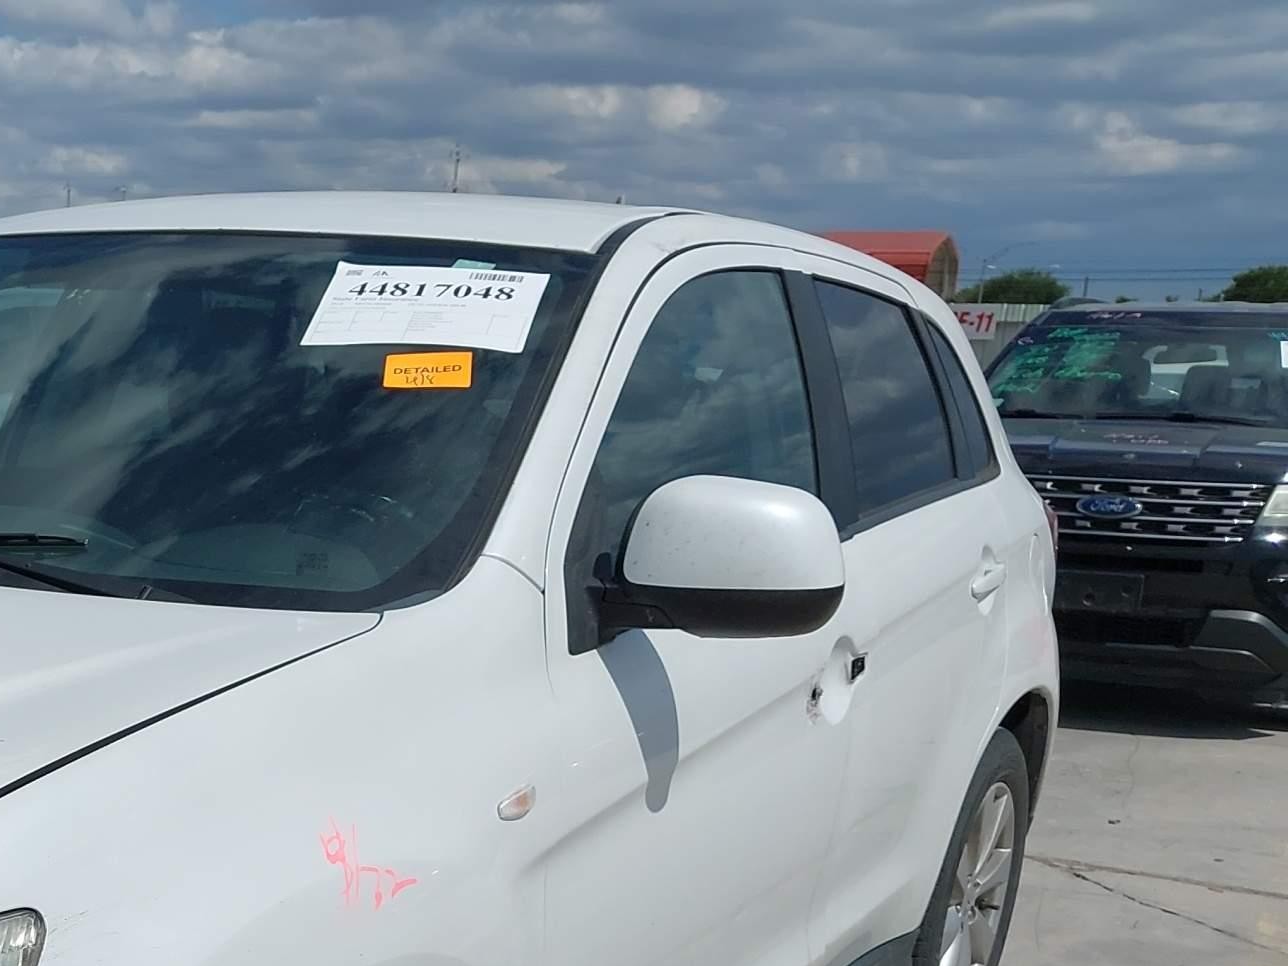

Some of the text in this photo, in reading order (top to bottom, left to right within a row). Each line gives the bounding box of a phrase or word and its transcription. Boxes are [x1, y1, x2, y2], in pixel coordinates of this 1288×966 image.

[349, 281, 516, 300] 44817048
[393, 364, 463, 375] DETAILED
[1089, 498, 1128, 513] Ford
